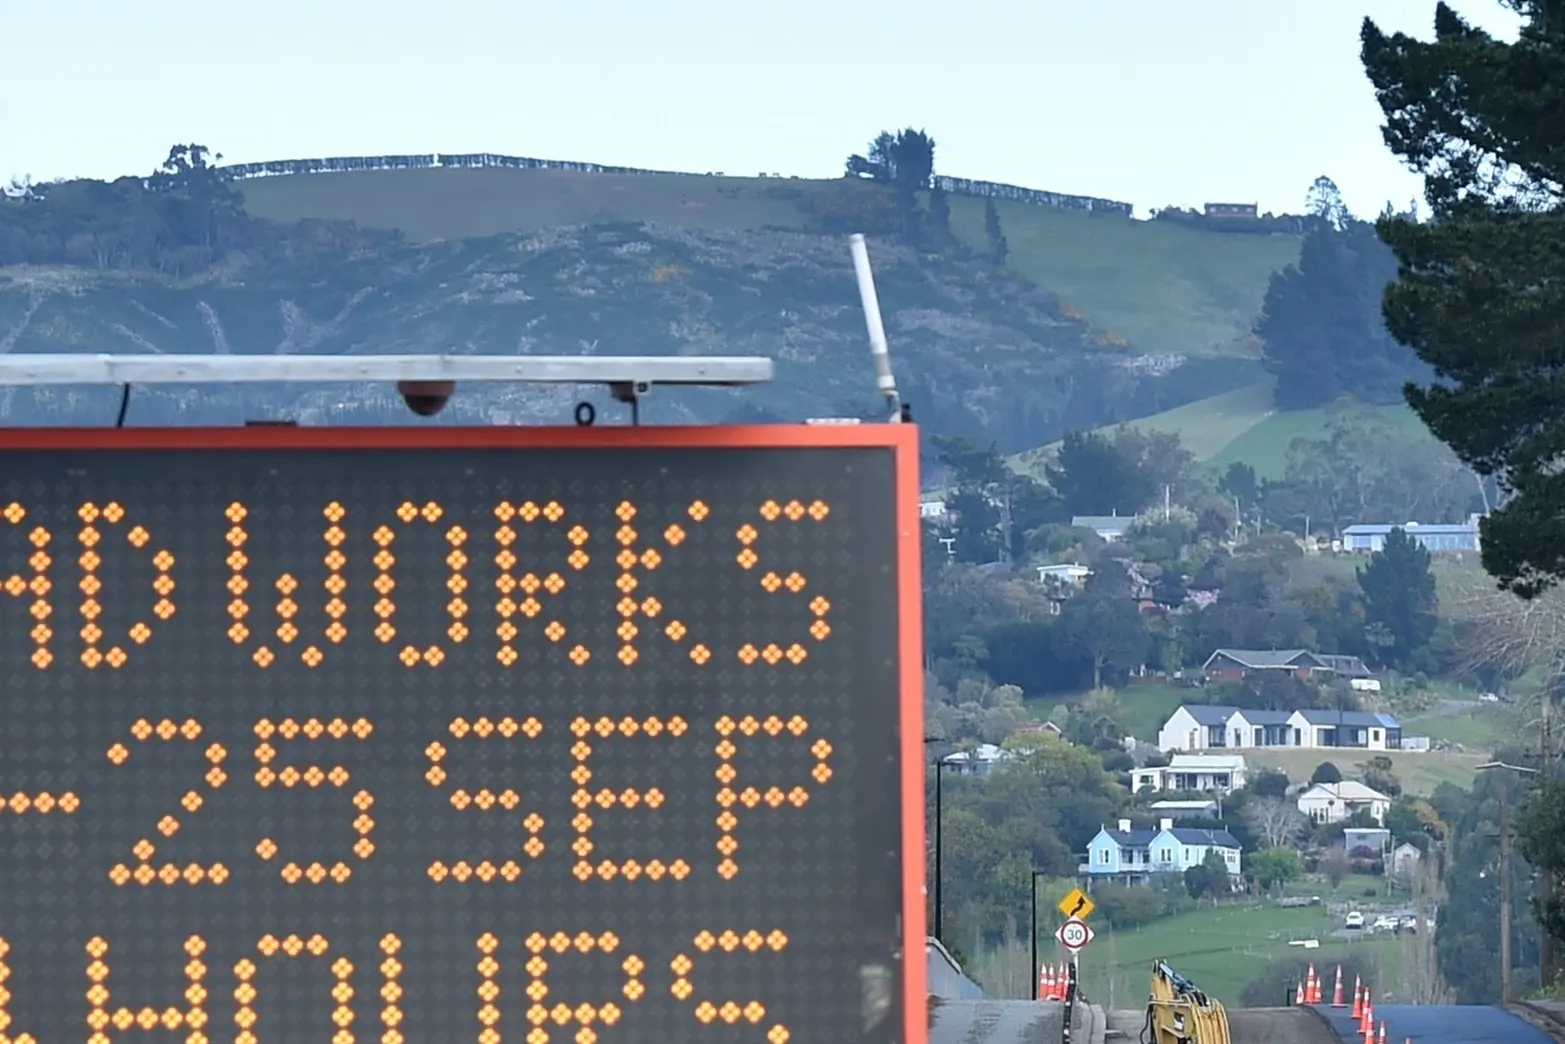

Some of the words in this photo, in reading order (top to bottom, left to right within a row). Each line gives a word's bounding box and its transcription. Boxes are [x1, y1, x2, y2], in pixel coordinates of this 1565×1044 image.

[227, 500, 830, 666] WORKS
[425, 716, 834, 881] SEP
[1068, 930, 1082, 940] 30
